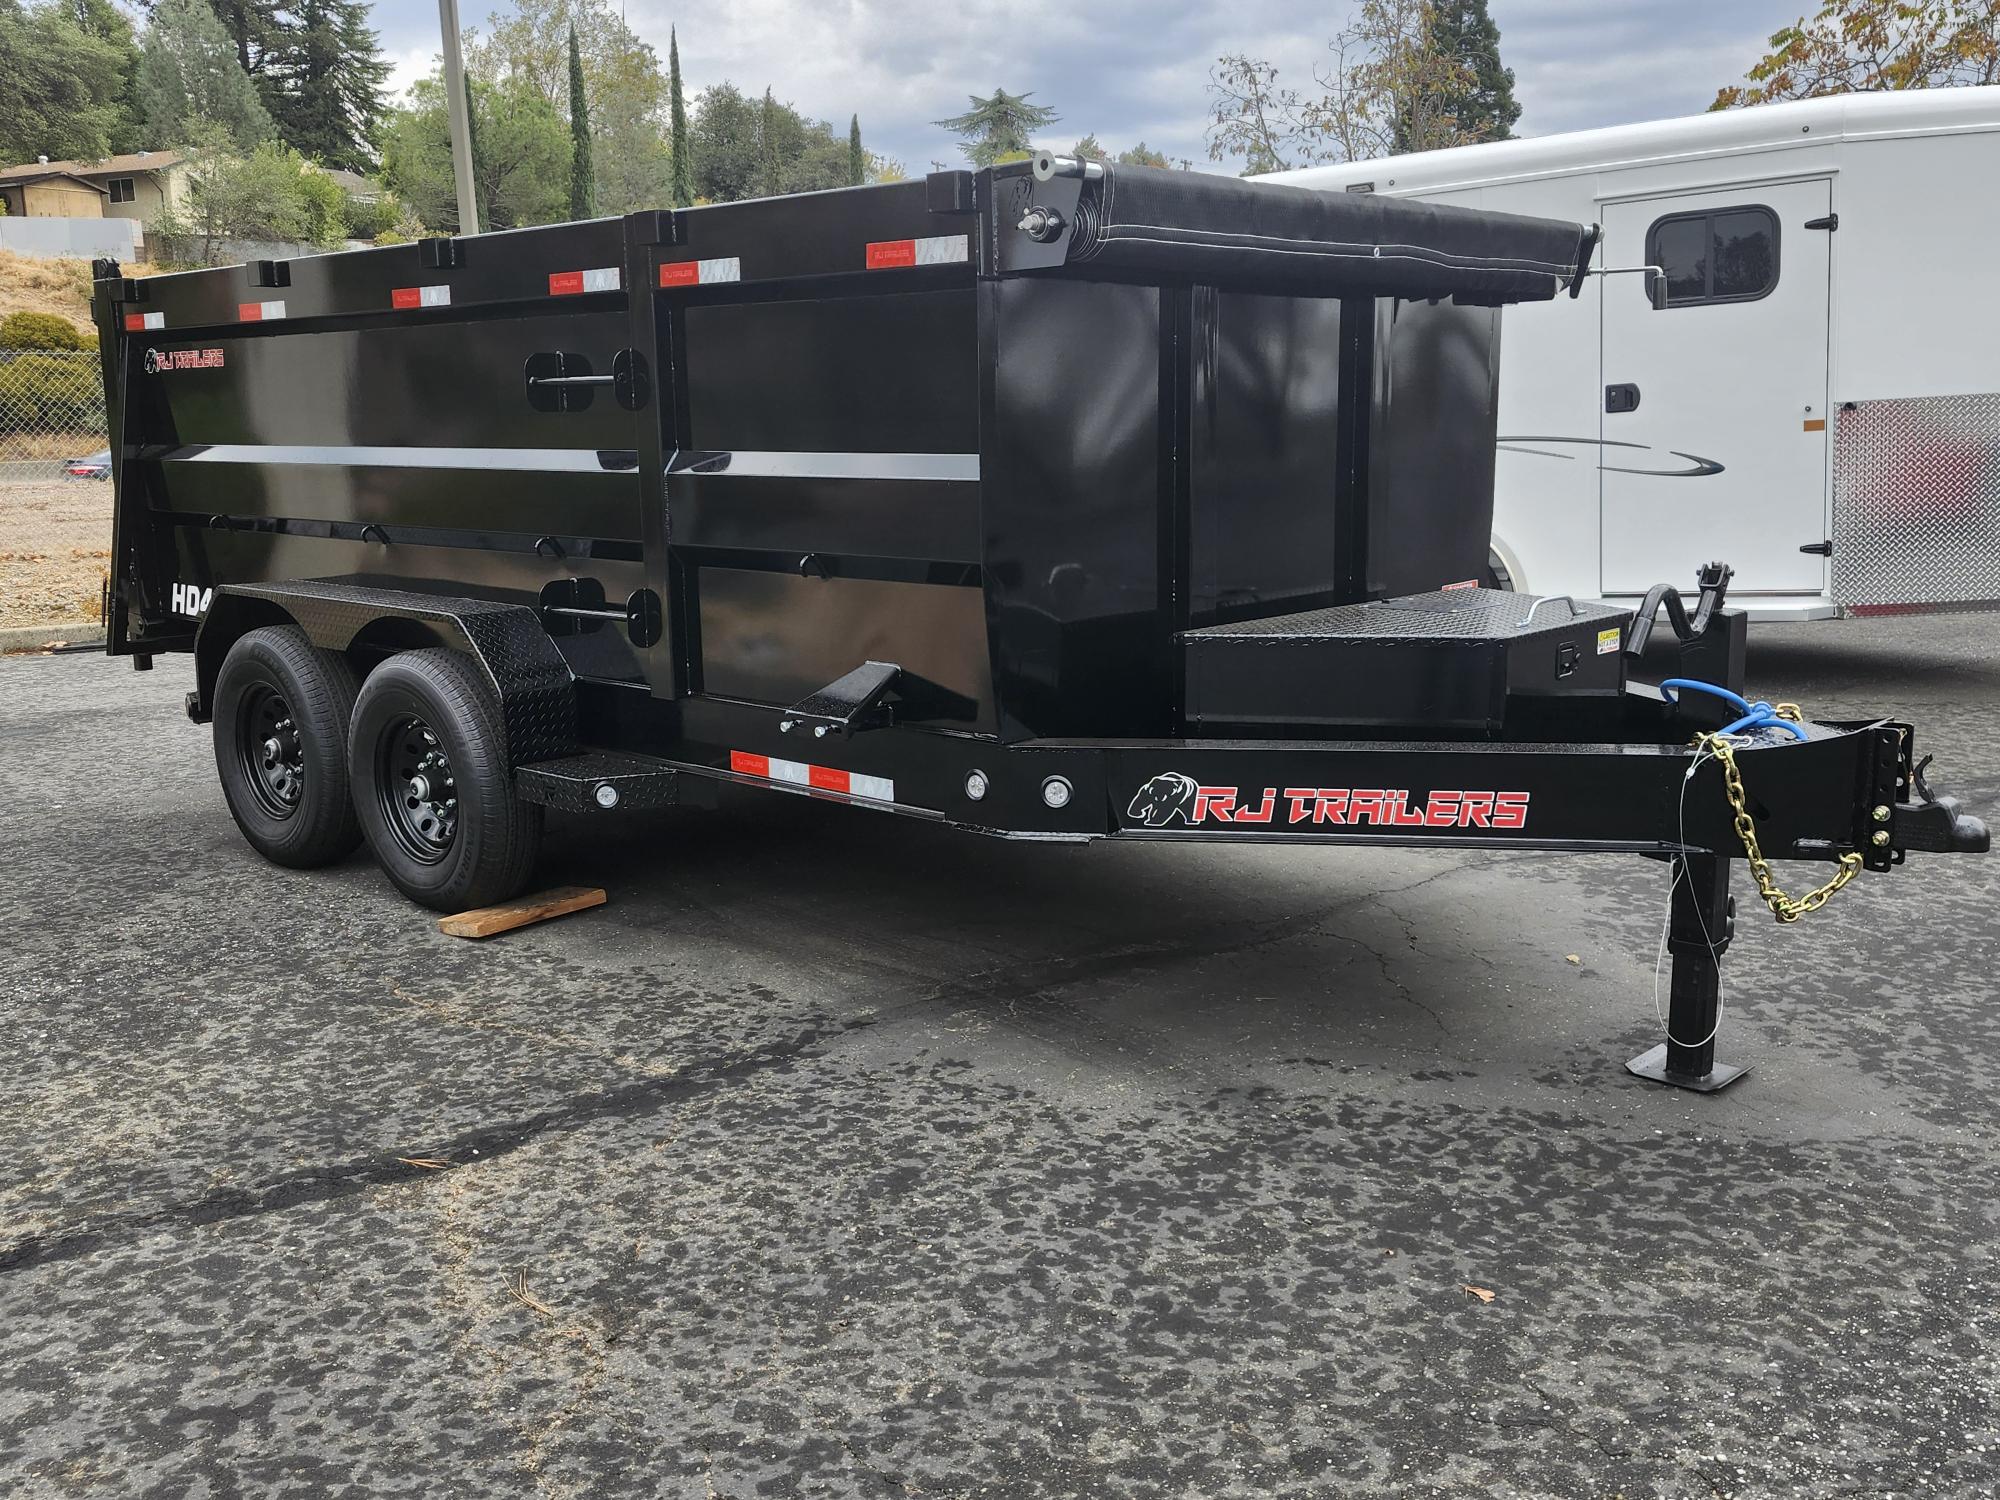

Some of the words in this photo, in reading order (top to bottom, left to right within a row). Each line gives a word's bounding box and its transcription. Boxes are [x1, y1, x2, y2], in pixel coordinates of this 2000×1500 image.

[156, 352, 173, 370] RJ
[174, 349, 224, 369] TRAILERS
[1193, 786, 1275, 823] RJ
[1284, 787, 1530, 828] TRAILERS
